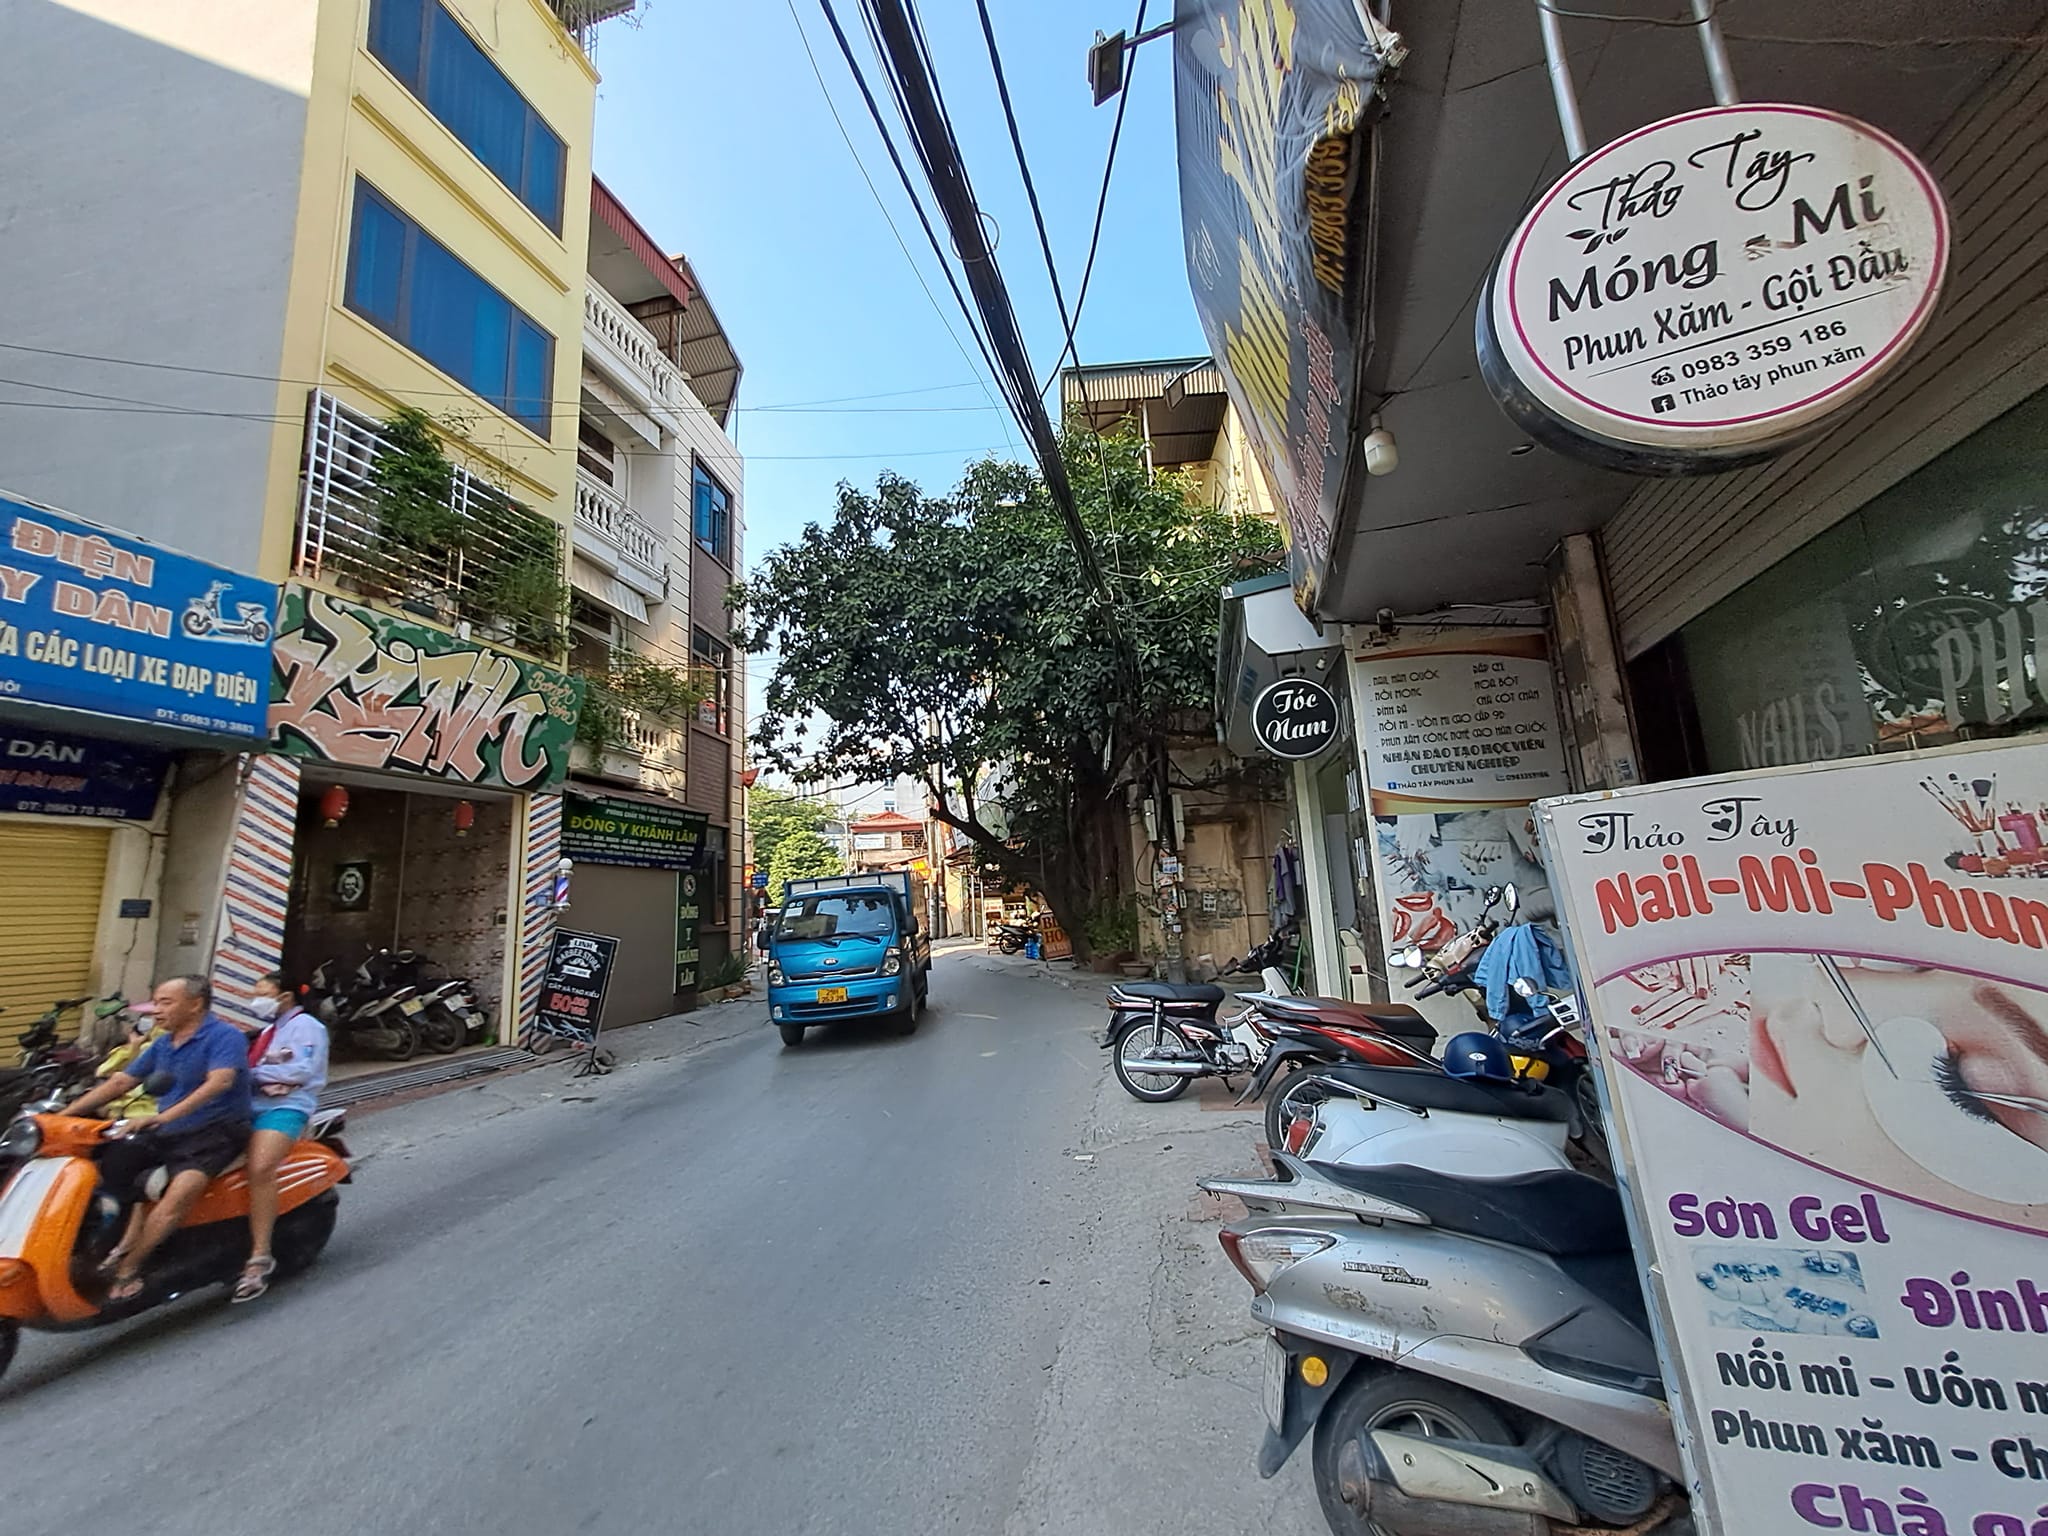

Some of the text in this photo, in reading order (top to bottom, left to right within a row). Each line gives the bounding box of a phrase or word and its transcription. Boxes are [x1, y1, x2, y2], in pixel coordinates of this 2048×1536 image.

[1568, 129, 1815, 229] Thảo Tây
[1548, 175, 1886, 322] Móng Mi
[1565, 328, 1647, 370] Phun
[1654, 302, 1733, 345] Xăm
[1762, 264, 1823, 312] Gội
[1680, 344, 1866, 405] Thảo tây phun xăm
[1681, 320, 1847, 380] 0983 359 186
[12, 516, 155, 588] ĐIỆN
[53, 580, 173, 640] DÂN
[26, 629, 79, 667] CÁC
[83, 643, 136, 683] LOẠI
[140, 658, 167, 686] XE
[172, 662, 212, 698] ĐẠP
[215, 672, 257, 707] ĐIỆN
[181, 713, 211, 726] 0983
[212, 718, 227, 729] 70
[1265, 717, 1330, 743] Nam
[1272, 688, 1319, 714] Tóc
[7, 740, 85, 764] DÂN
[1382, 750, 1421, 764] NHẬN
[1433, 777, 1455, 787] PHUN
[620, 822, 628, 835] Y
[631, 824, 674, 841] KHÁNH
[1578, 797, 1800, 855] Thảo Tây
[1669, 1194, 1891, 1244] Sơn Gel
[1716, 1337, 1792, 1392] Nối
[1800, 1355, 1859, 1398] mi
[1904, 1350, 2009, 1411] Uốn
[1711, 1409, 1829, 1457] Phun
[1835, 1416, 1942, 1469] xăm
